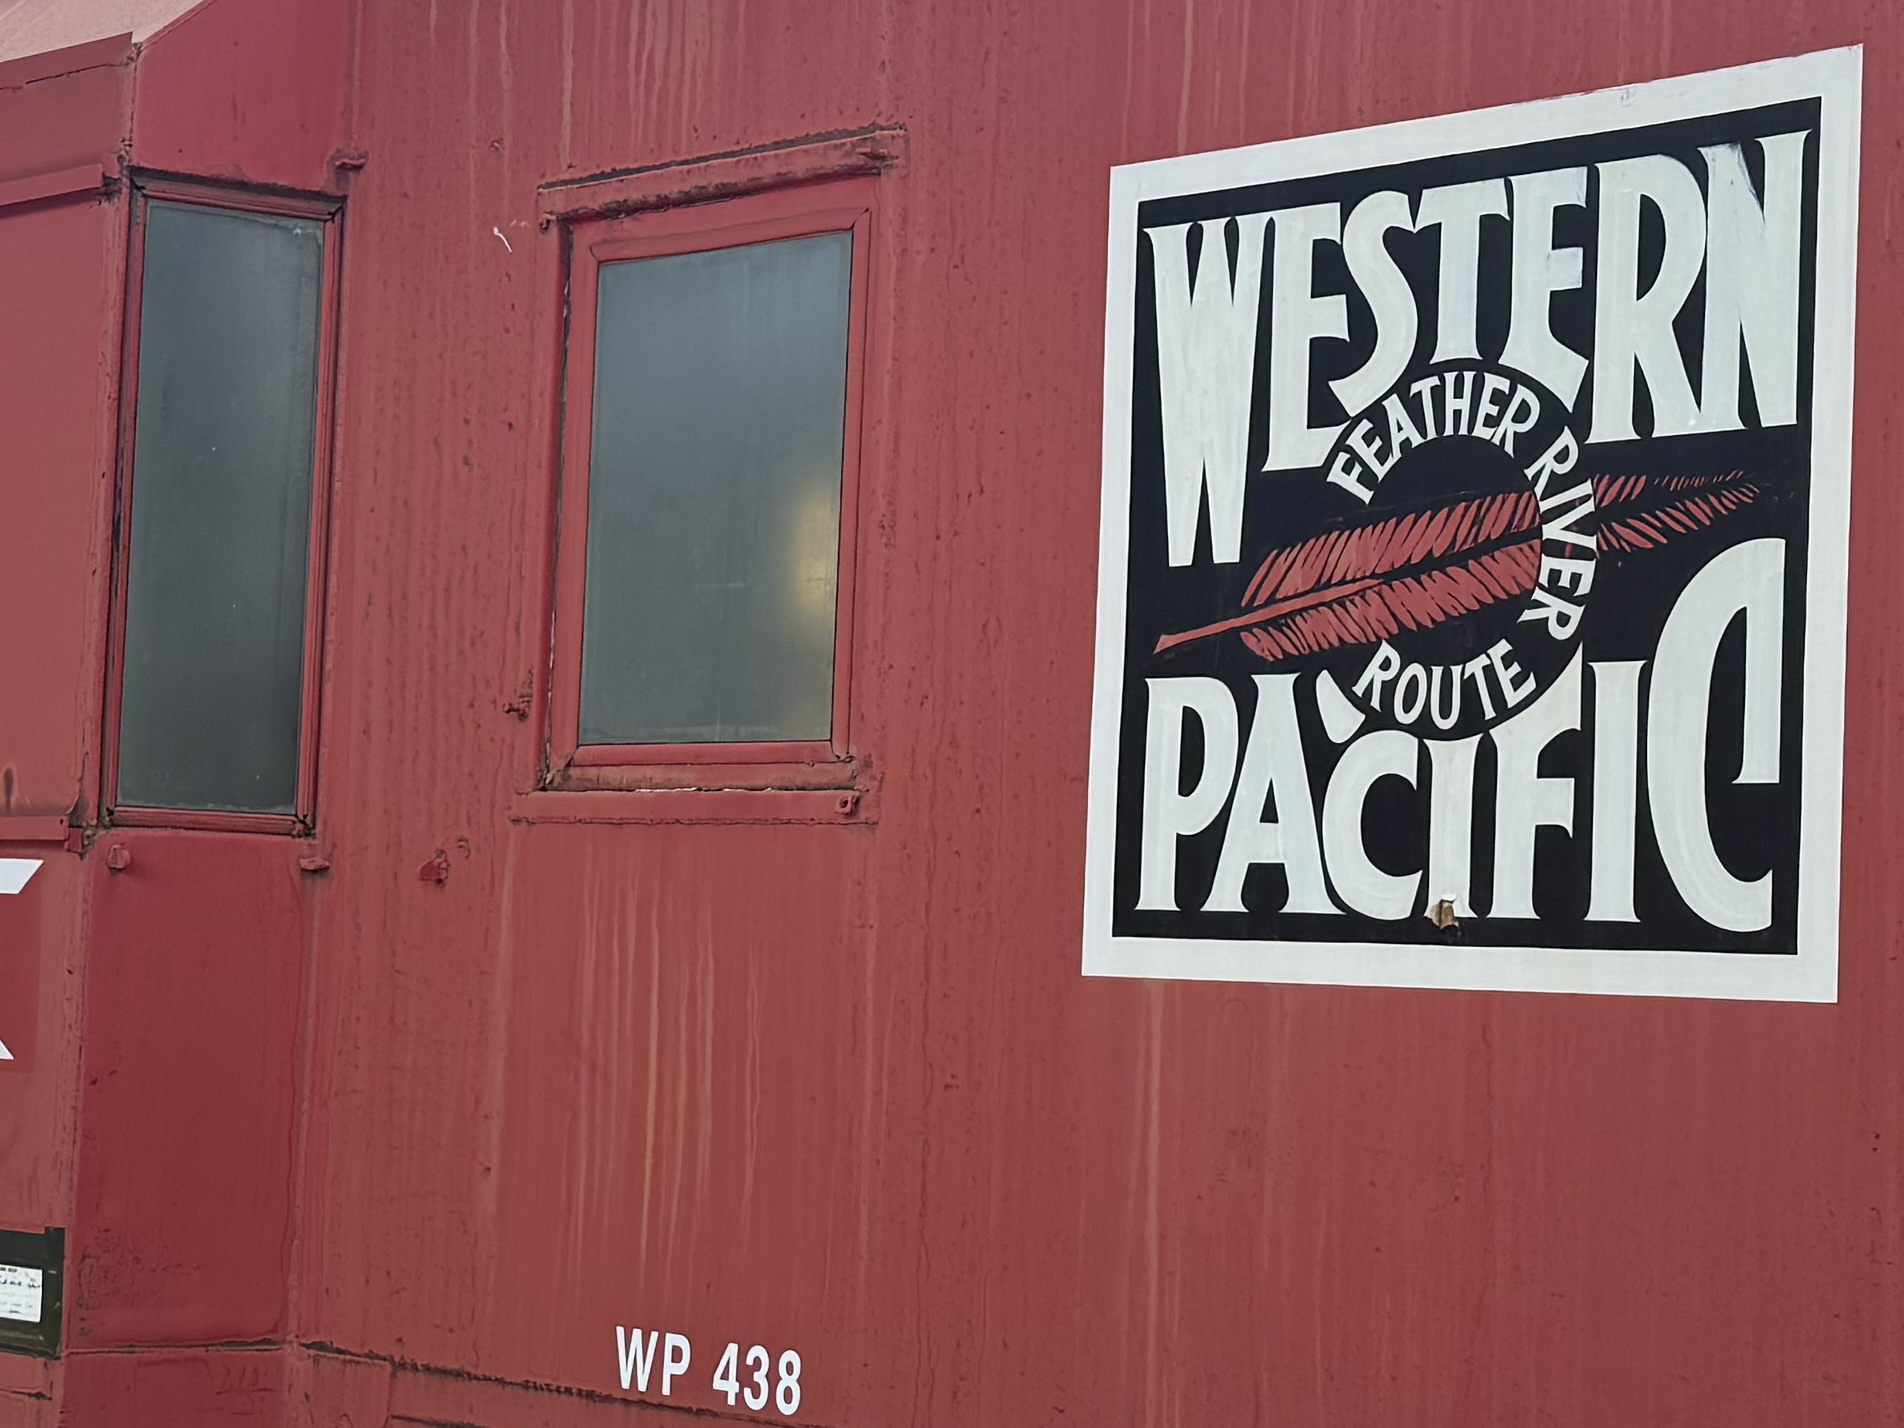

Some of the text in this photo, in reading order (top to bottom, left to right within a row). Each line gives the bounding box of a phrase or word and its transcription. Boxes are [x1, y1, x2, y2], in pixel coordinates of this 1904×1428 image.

[1143, 129, 1812, 567] WESTERN
[1327, 371, 1597, 642] FEATHER RIVER
[1135, 538, 1787, 932] PACIFIC
[1352, 638, 1536, 730] ROUTE
[616, 1325, 803, 1416] WP 438
